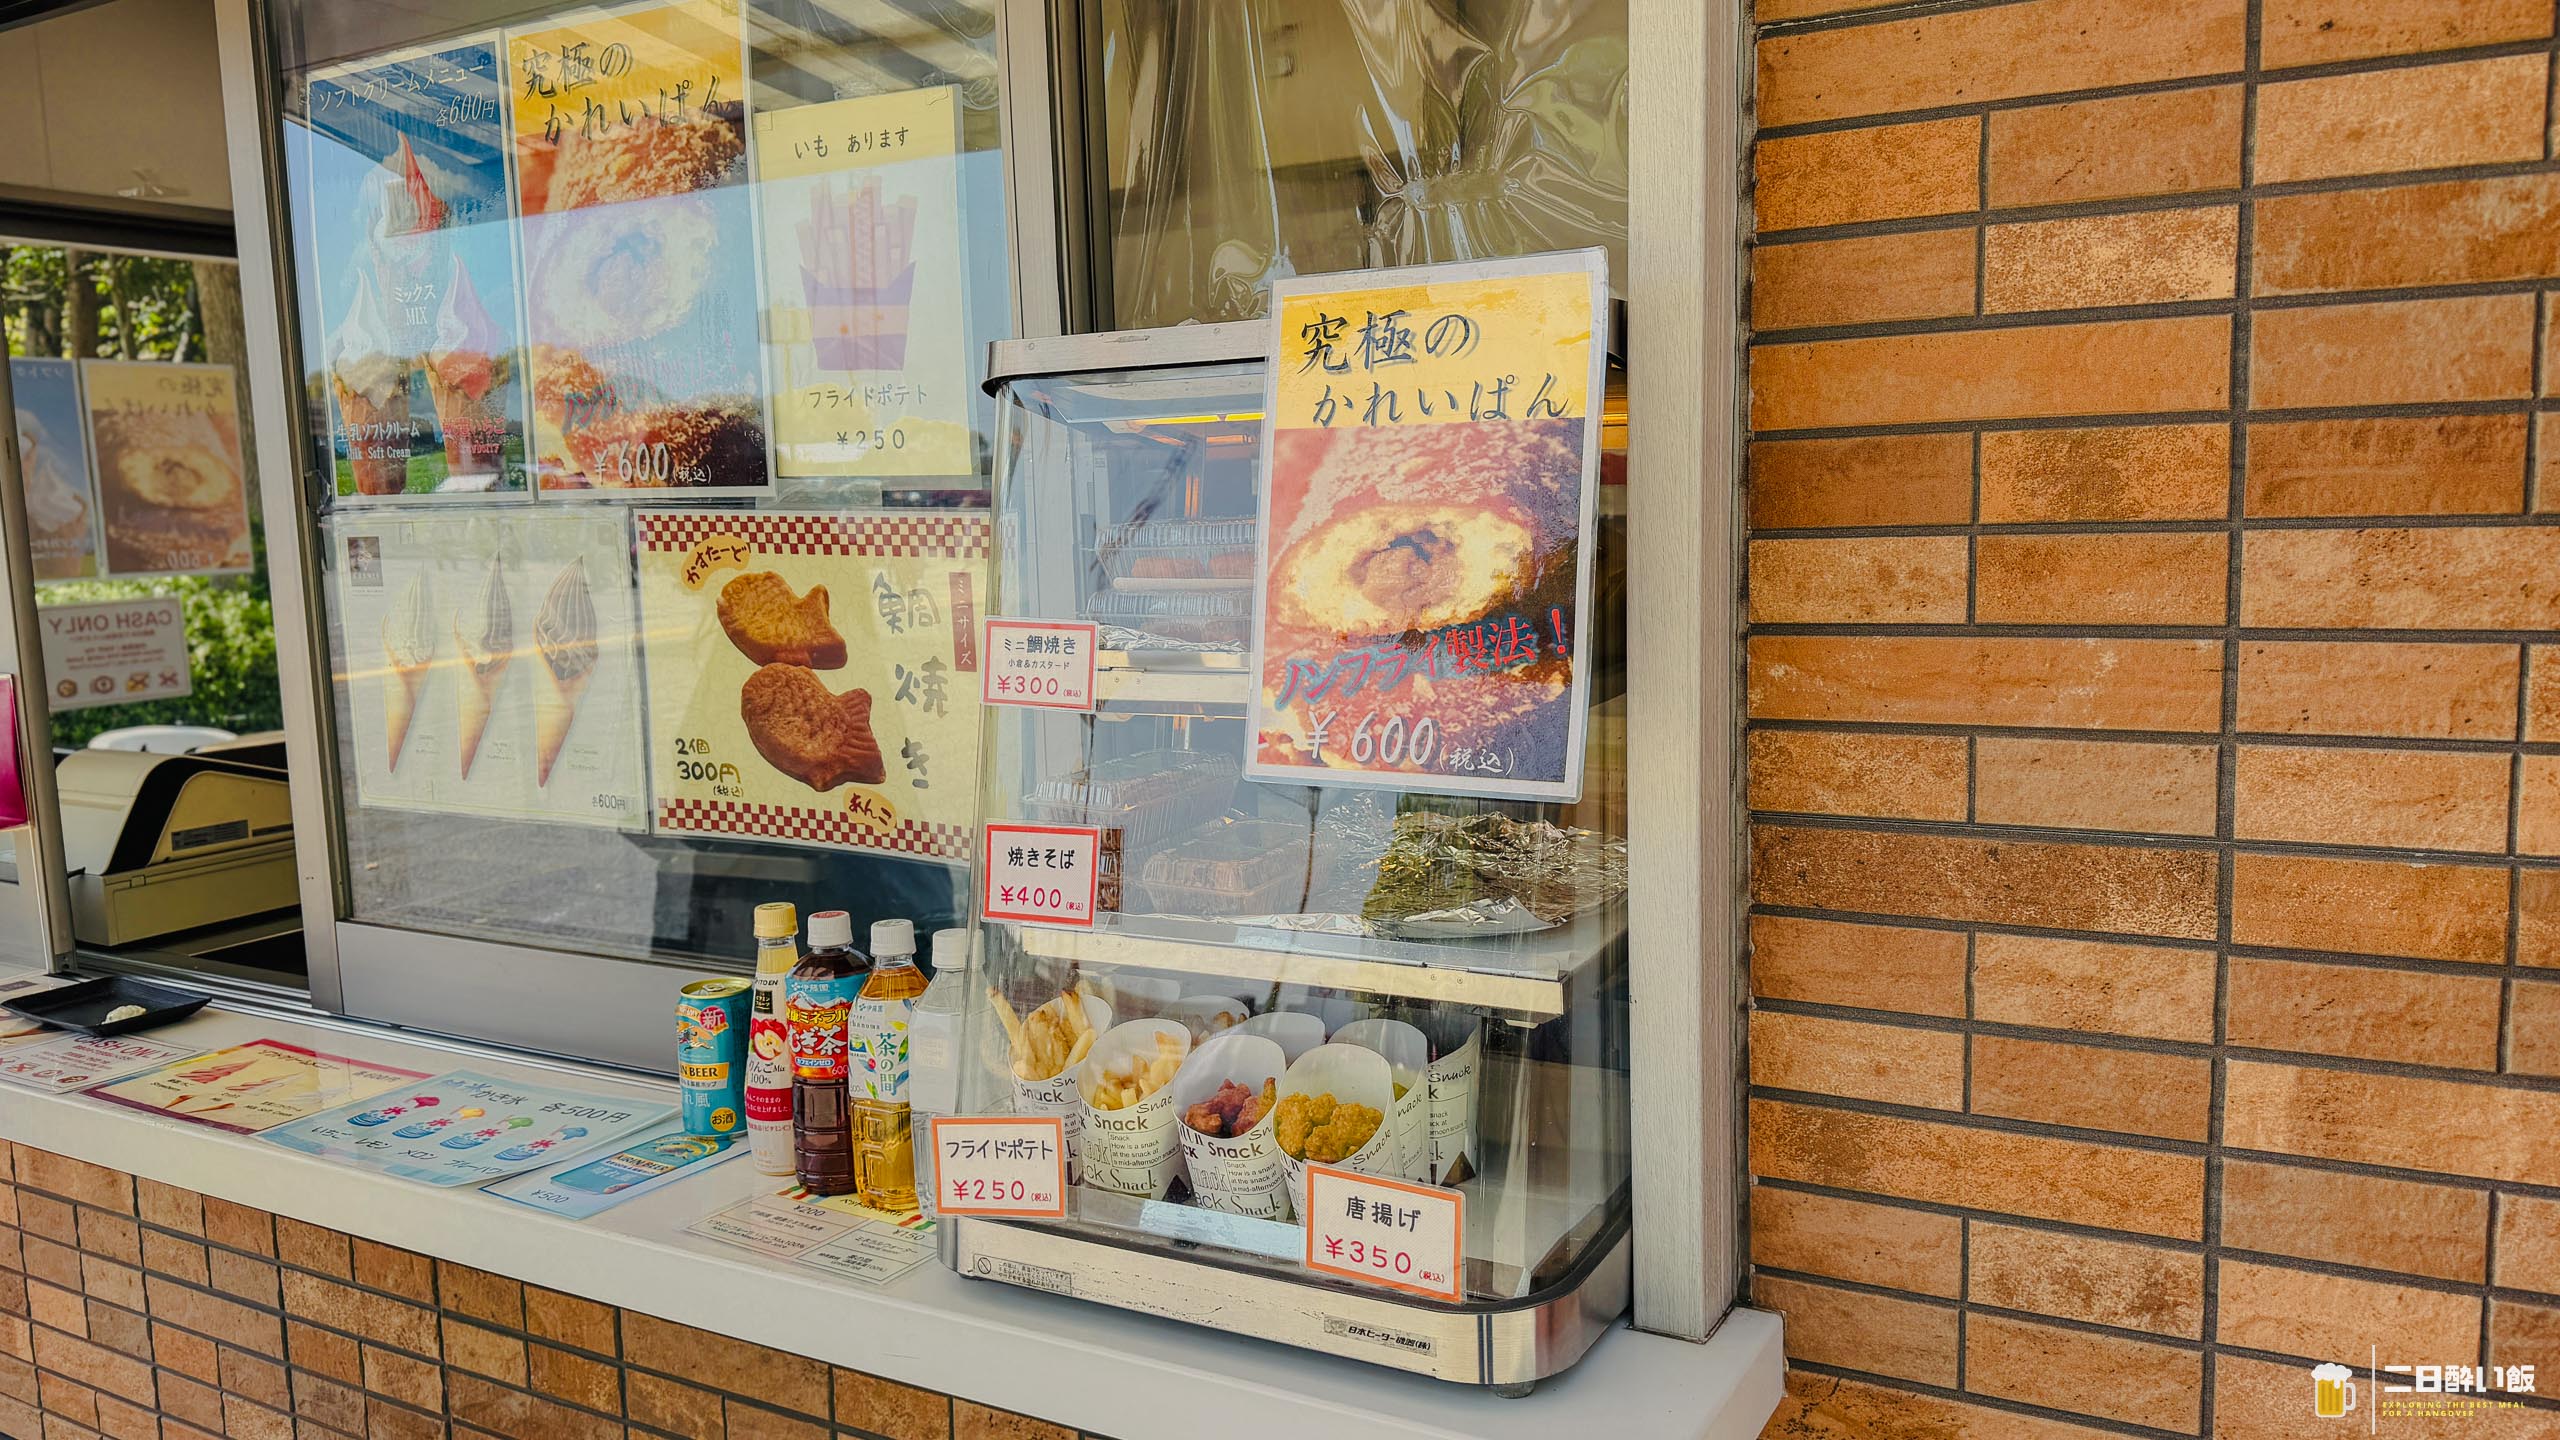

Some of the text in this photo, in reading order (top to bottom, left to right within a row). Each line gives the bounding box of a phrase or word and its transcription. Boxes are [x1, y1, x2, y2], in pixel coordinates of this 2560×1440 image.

[521, 41, 633, 102] 究極の
[319, 65, 484, 112] ソフトクリームメニュー
[434, 91, 495, 128] 各600円
[544, 74, 738, 146] かれいぱん
[795, 126, 909, 159] いも あります
[393, 284, 436, 303] ミックス
[1297, 309, 1472, 375] 究極の
[809, 384, 928, 409] フライドポテト
[1312, 372, 1569, 429] かれいぱん
[836, 429, 905, 450] ¥250
[367, 446, 385, 459] Soft
[386, 446, 412, 459] Cream
[593, 441, 712, 486] ¥600 (税込)
[685, 544, 748, 585] かすたーど
[956, 579, 974, 667] ミニサイズ
[1004, 634, 1076, 655] ミニ鯛焼き
[1008, 658, 1070, 670] 小倉&カスタード
[872, 571, 949, 790] 鯛焼き
[997, 674, 1059, 695] ¥300
[675, 738, 710, 755] 2個
[1307, 710, 1514, 776] ¥600 (税込)
[676, 760, 742, 784] 300円
[712, 785, 744, 798] (税込)
[848, 792, 893, 826] あんこ
[1008, 846, 1075, 870] 焼きそば
[1000, 884, 1062, 909] ¥400
[703, 1008, 724, 1031] 新
[787, 1024, 848, 1056] むぎ茶
[121, 1046, 177, 1061] ONLY
[796, 1058, 832, 1067] カフェインゼロ
[876, 1032, 897, 1096] 茶の間
[689, 1067, 719, 1078] BEER
[470, 1089, 529, 1106] かき氷
[1020, 1082, 1065, 1103] Snack
[539, 1101, 632, 1124] 各500円
[711, 1112, 734, 1125] お酒
[1094, 1114, 1149, 1132] Snack
[310, 1125, 353, 1140] いちご
[354, 1137, 392, 1150] レモン
[398, 1149, 440, 1161] メロン
[946, 1138, 1053, 1160] フライドポテト
[1131, 1149, 1152, 1158] snack
[1140, 1139, 1160, 1149] snack
[1207, 1141, 1264, 1159] Snack
[1351, 1129, 1392, 1166] Snack
[1238, 1177, 1250, 1185] the
[1250, 1173, 1270, 1184] snack
[1258, 1161, 1277, 1175] snack
[952, 1179, 1025, 1201] ¥250
[1109, 1168, 1158, 1191] Snack
[530, 1188, 571, 1204] ¥500
[1230, 1192, 1282, 1217] Snack
[793, 1204, 826, 1217] ¥200
[1346, 1195, 1421, 1233] 唐揚げ
[892, 1228, 926, 1242] ¥150
[1325, 1234, 1445, 1284] ¥350 (税込)
